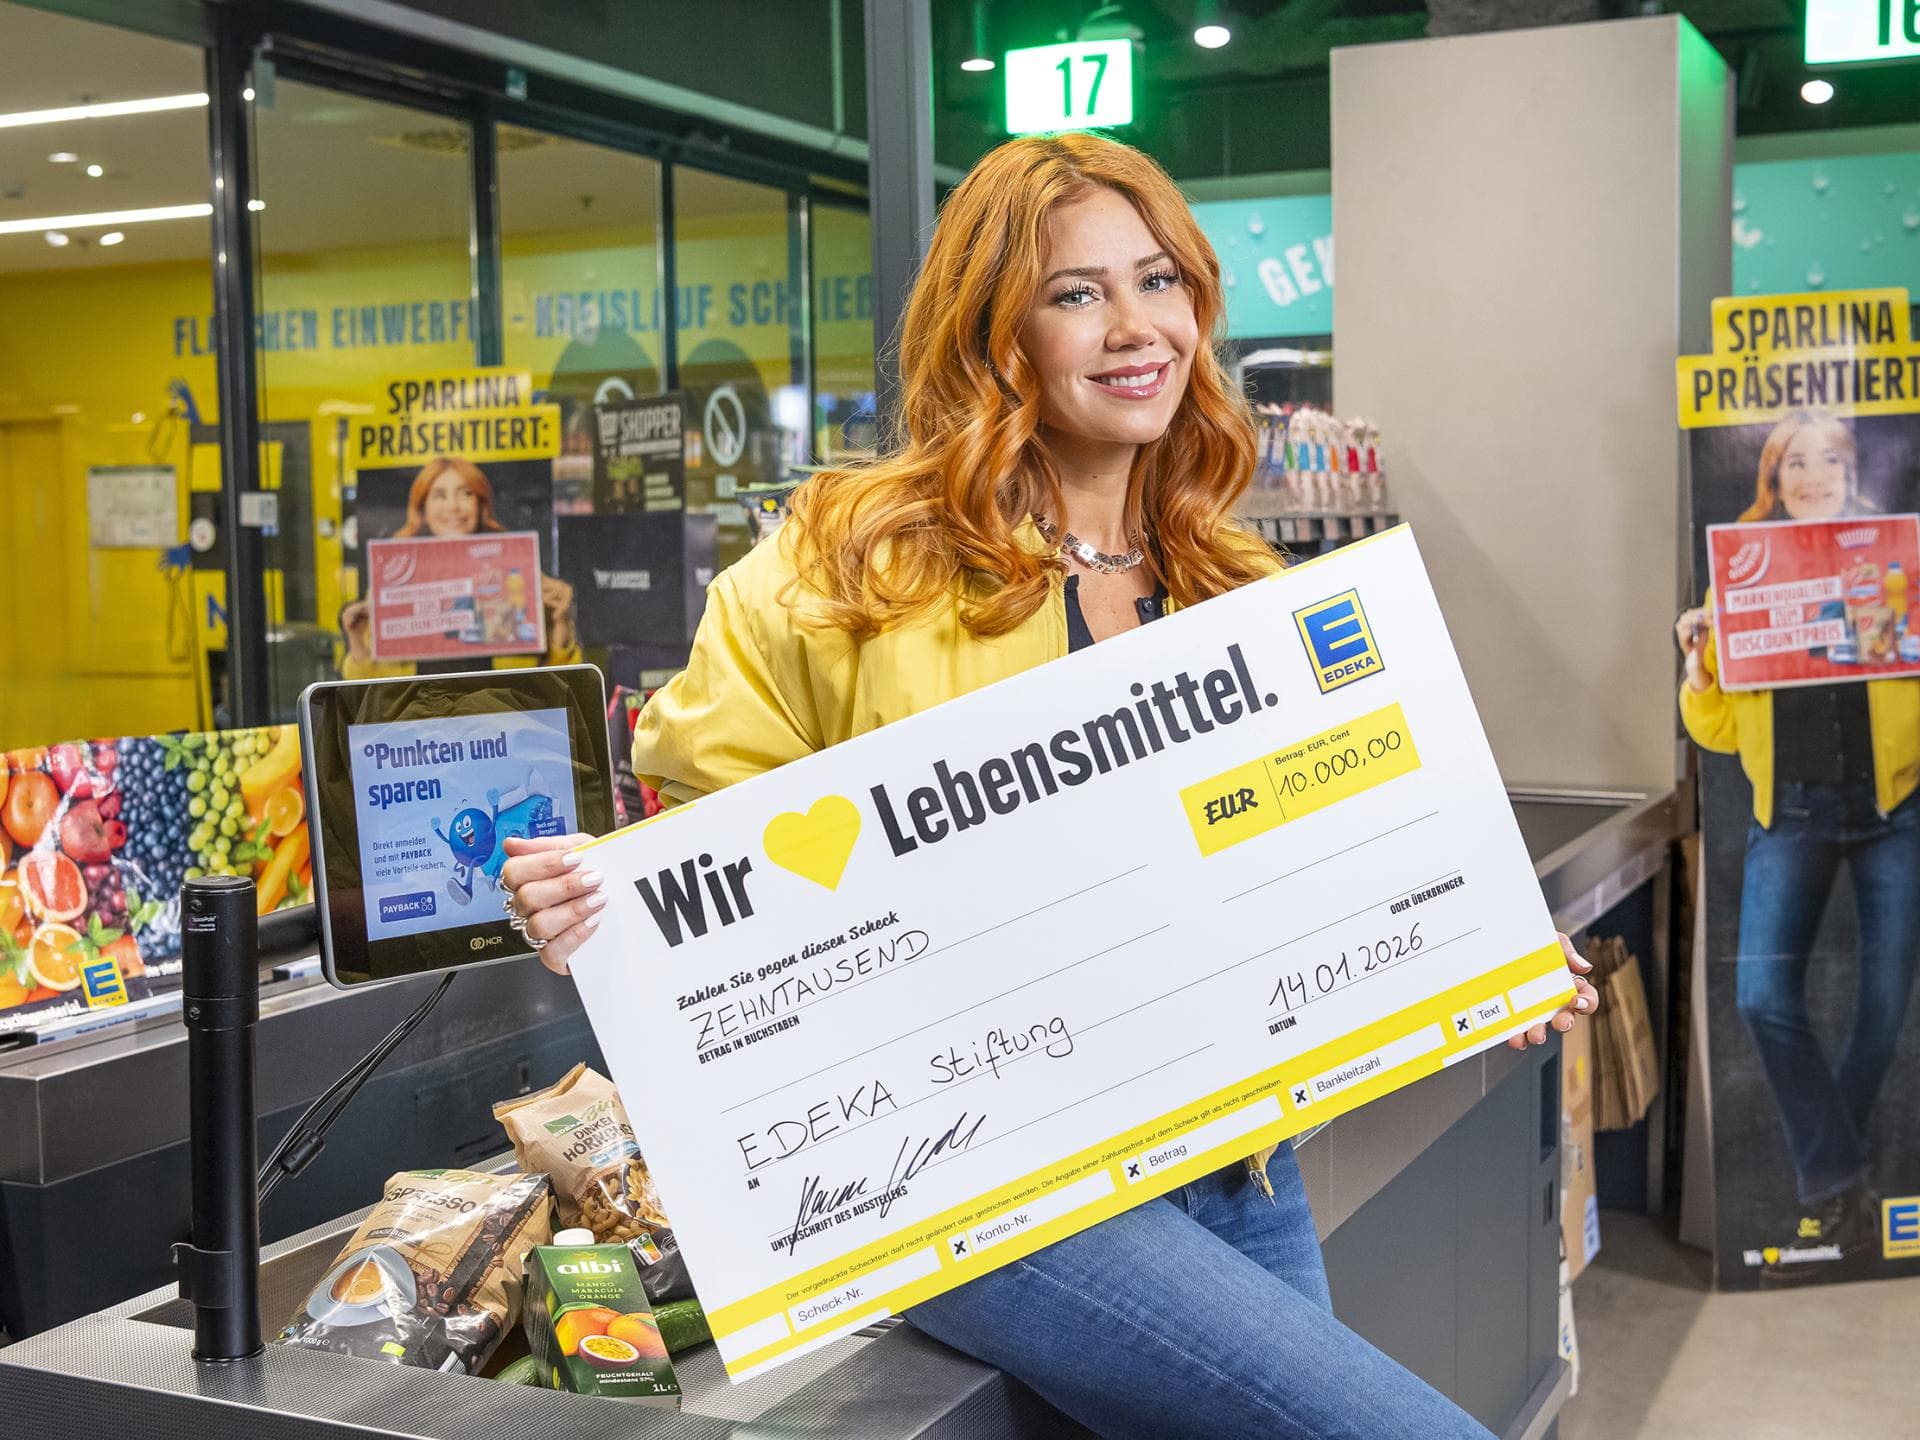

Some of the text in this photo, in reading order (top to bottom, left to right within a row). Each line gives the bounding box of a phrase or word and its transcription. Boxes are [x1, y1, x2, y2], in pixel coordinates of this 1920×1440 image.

[1055, 53, 1108, 118] 17
[331, 299, 479, 348] EINWERF
[1726, 299, 1896, 353] SPARLINA
[388, 375, 520, 414] SPARLINA
[360, 415, 550, 458] PRÄSENTIERT:
[1323, 656, 1376, 684] EDEKA
[469, 731, 508, 760] und
[1274, 729, 1351, 766] Betrag: EUR, Cent
[1279, 730, 1401, 798] 10.000,00
[368, 777, 442, 809] sparen
[633, 642, 1279, 949] Wir Lebensmittel.
[1203, 787, 1259, 826] EUR
[373, 836, 426, 851] Direkt anmelden
[374, 848, 433, 864] und mit PAYBACK
[376, 861, 447, 877] viele Vorteile sichern.
[383, 901, 420, 914] PAYBACK
[1389, 875, 1466, 915] ODER ÜBERBRINGER
[485, 936, 503, 946] NCR
[676, 910, 900, 1011] Zahlen Sie gegen diesen Scheck
[1268, 922, 1425, 1013] 14.01.2026
[689, 929, 931, 1051] ZEHNTAUSEND
[1268, 1015, 1297, 1036] DATUM
[1476, 1004, 1501, 1020] Text
[698, 1014, 801, 1065] BETRAG IN BUCHSTABEN
[1315, 1056, 1381, 1093] Bankleitzahl
[736, 1016, 1074, 1171] EDEKA Stiftung
[1148, 1144, 1188, 1167] Betrag
[747, 1176, 761, 1191] AN
[785, 1290, 800, 1301] Der
[800, 1269, 849, 1294] vorgedruckte
[846, 1250, 890, 1273] Schecktext
[890, 1243, 905, 1255] darf
[904, 1235, 925, 1249] nicht
[925, 1221, 957, 1242] geändert
[956, 1214, 974, 1226] oder
[975, 1197, 1012, 1220] gestrichen
[1040, 1179, 1054, 1189] Die
[1055, 1167, 1082, 1183] Angabe
[1082, 1159, 1099, 1171] einer
[1101, 1138, 1145, 1163] Zahlungsfrist
[1144, 1132, 1157, 1143] auf
[1157, 1126, 1174, 1138] dem
[1173, 1115, 1200, 1131] Scheck
[1199, 1109, 1211, 1121] gilt
[1211, 1105, 1223, 1114] als
[1222, 1096, 1241, 1109] nicht
[770, 1182, 908, 1252] UNTERSCHRIFT DES AUSSTELLERS
[975, 1214, 1032, 1244] Konto-Nr.
[556, 1259, 622, 1275] albi
[797, 1288, 864, 1322] Scheck-Nr.
[595, 1371, 654, 1379] FRUCHTGEHALT
[652, 1384, 668, 1392] 1L
